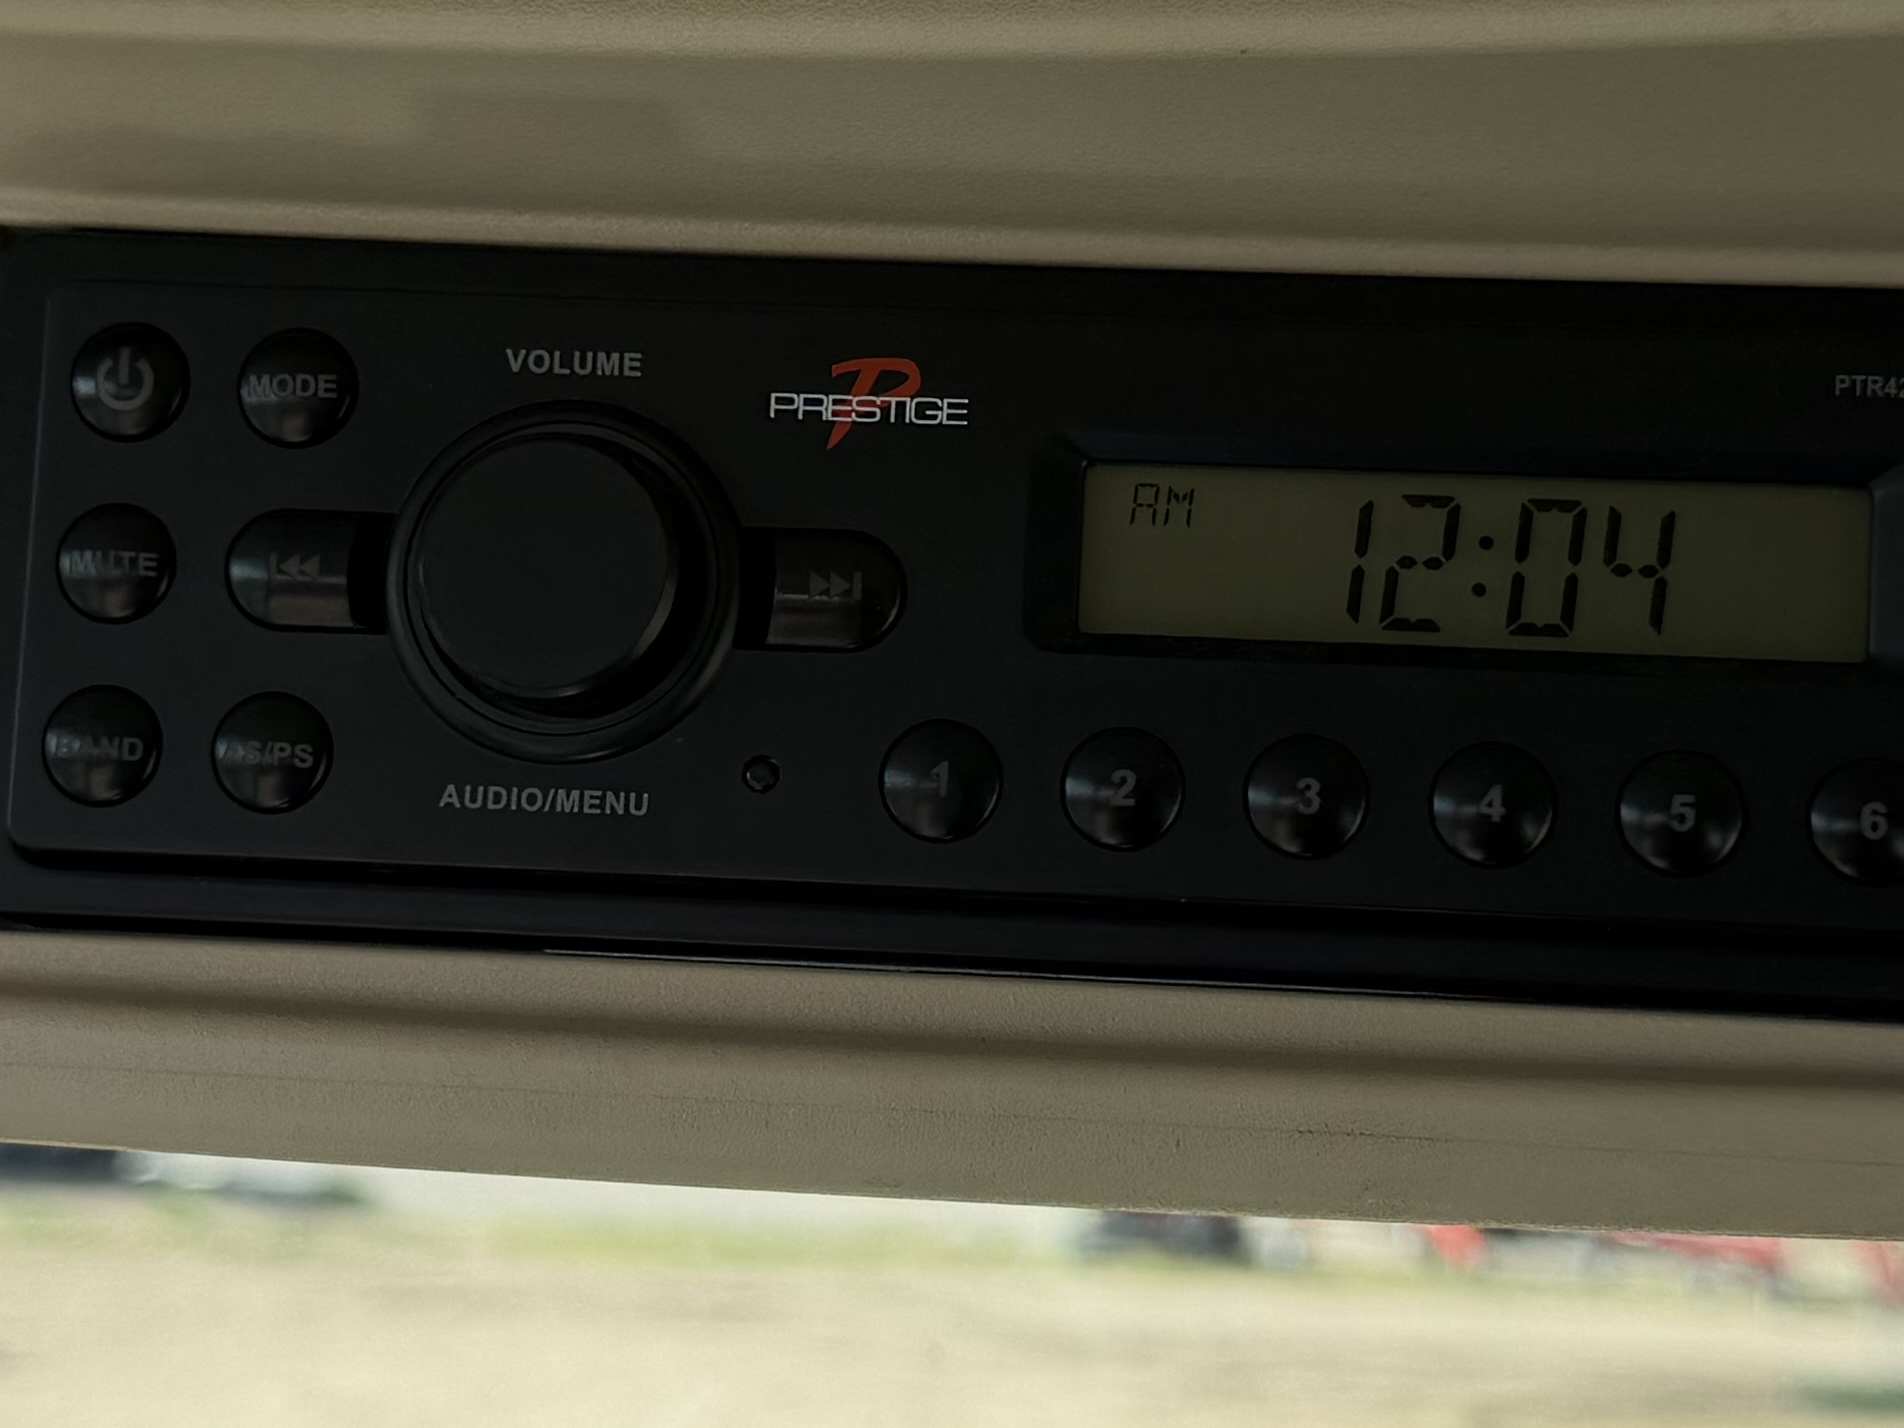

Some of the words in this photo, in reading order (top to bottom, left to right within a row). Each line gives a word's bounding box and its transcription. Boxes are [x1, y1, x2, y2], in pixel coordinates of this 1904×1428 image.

[505, 348, 643, 377] VOLUME
[247, 373, 338, 399] MODE
[768, 391, 970, 427] PRESTIGE
[68, 548, 160, 577] MUTE
[1129, 482, 1195, 529] AM
[1345, 493, 1677, 639] 12:04
[56, 734, 144, 762] BAND
[223, 738, 314, 769] AS/PS
[927, 760, 950, 798] 1
[1109, 769, 1138, 807] 2
[1296, 777, 1322, 815] 3
[438, 783, 650, 817] AUDIO/MENU
[1478, 784, 1506, 822] 4
[1669, 793, 1696, 832] 5
[1859, 801, 1890, 840] 6
